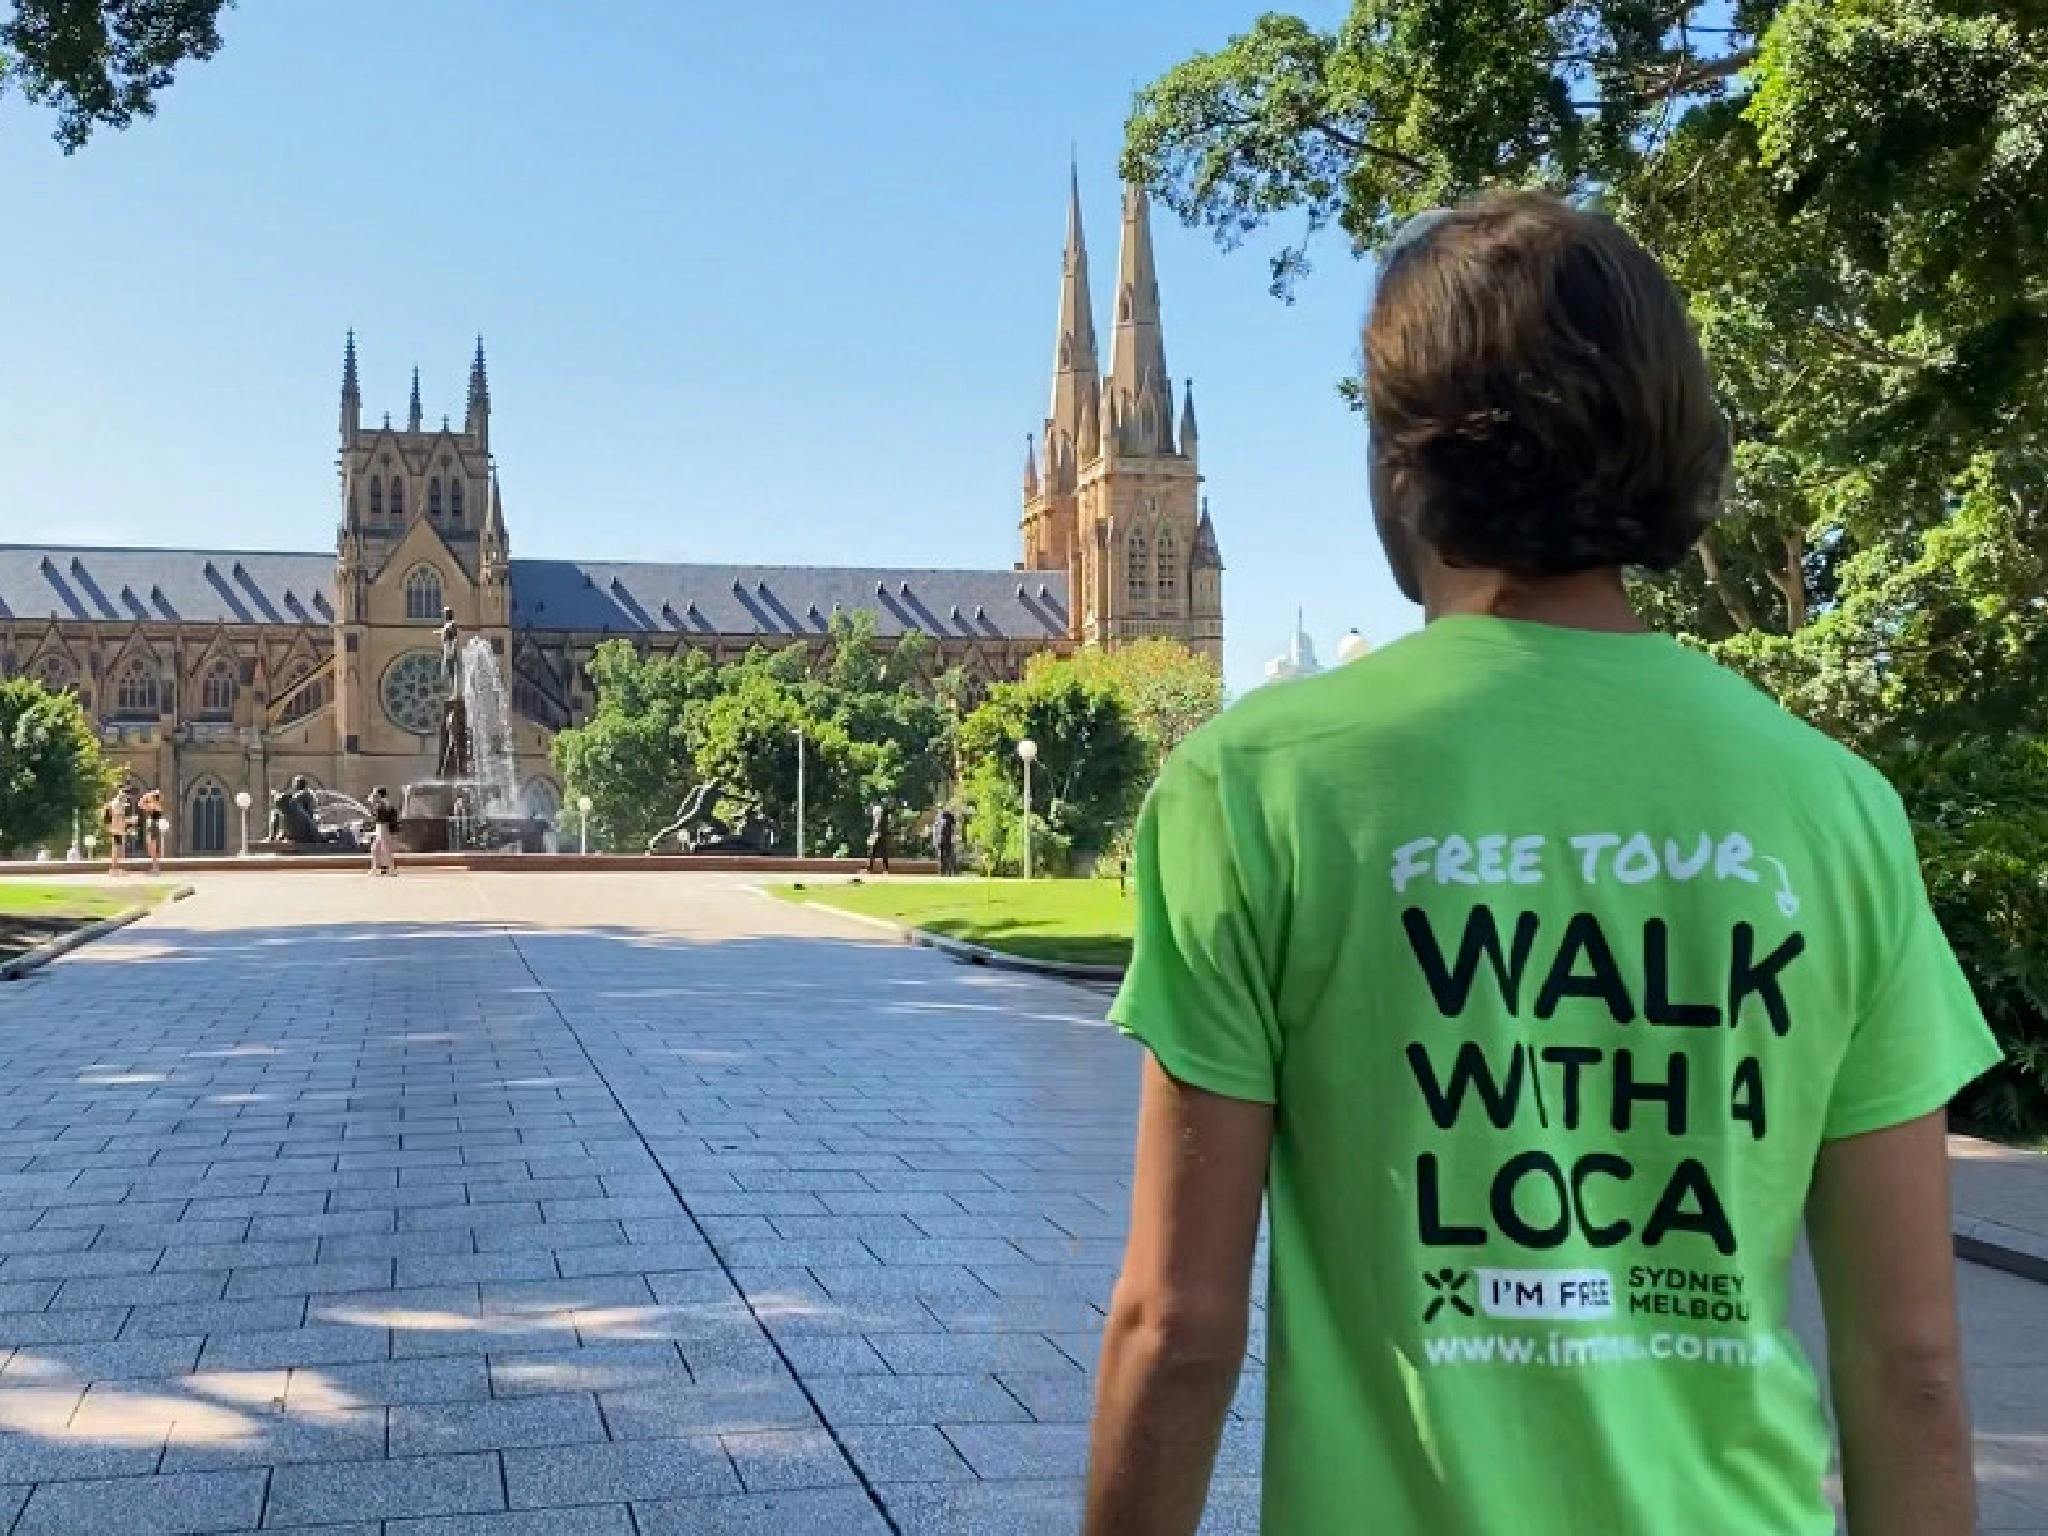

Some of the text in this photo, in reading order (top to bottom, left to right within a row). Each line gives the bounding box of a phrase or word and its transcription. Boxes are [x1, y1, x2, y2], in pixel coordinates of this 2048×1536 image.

[1391, 832, 1760, 893] FREE TOUR
[1402, 904, 1805, 1036] WALK
[1406, 1041, 1767, 1141] WITH A
[1492, 1278, 1544, 1307] I'M
[1628, 1265, 1745, 1297] SYDNEY
